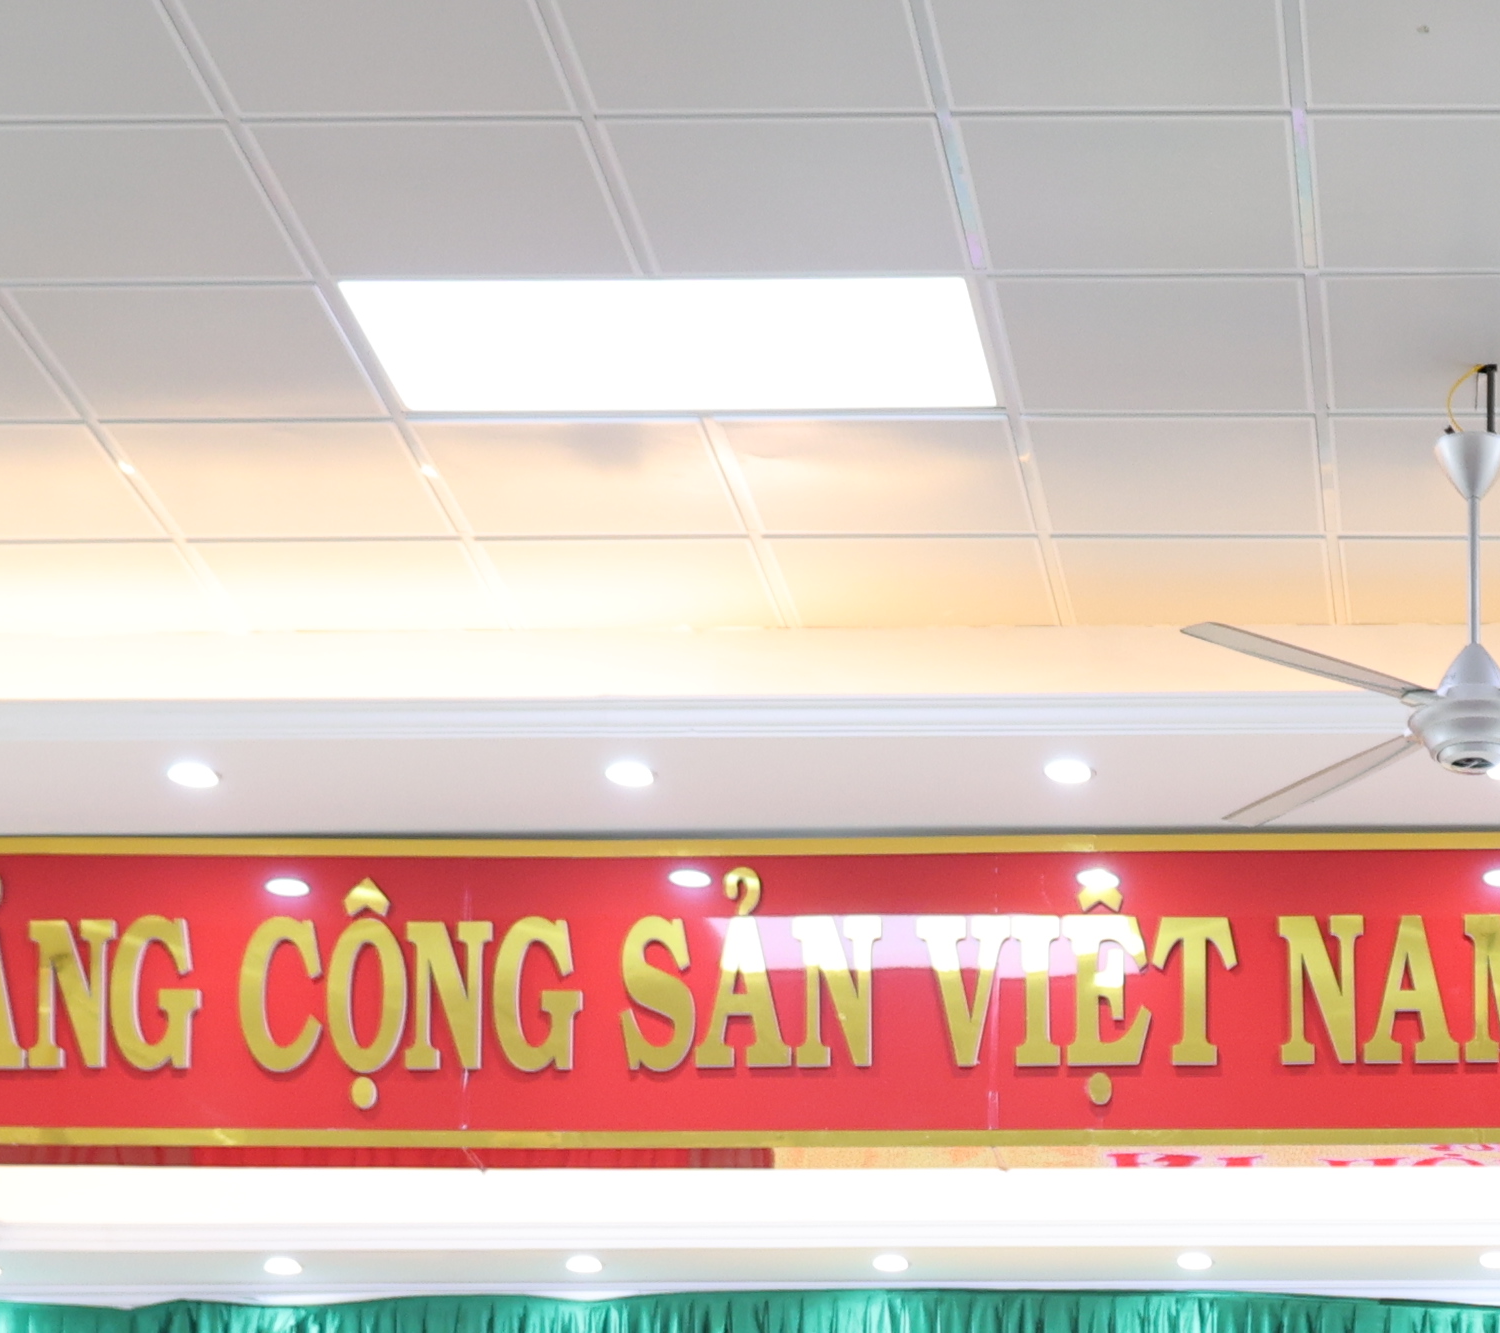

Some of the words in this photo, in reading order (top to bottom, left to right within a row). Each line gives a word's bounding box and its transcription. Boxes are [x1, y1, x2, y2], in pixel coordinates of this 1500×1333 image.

[238, 878, 583, 1110] CỘNG
[620, 866, 882, 1072] SẢN
[916, 886, 1241, 1106] VIỆT
